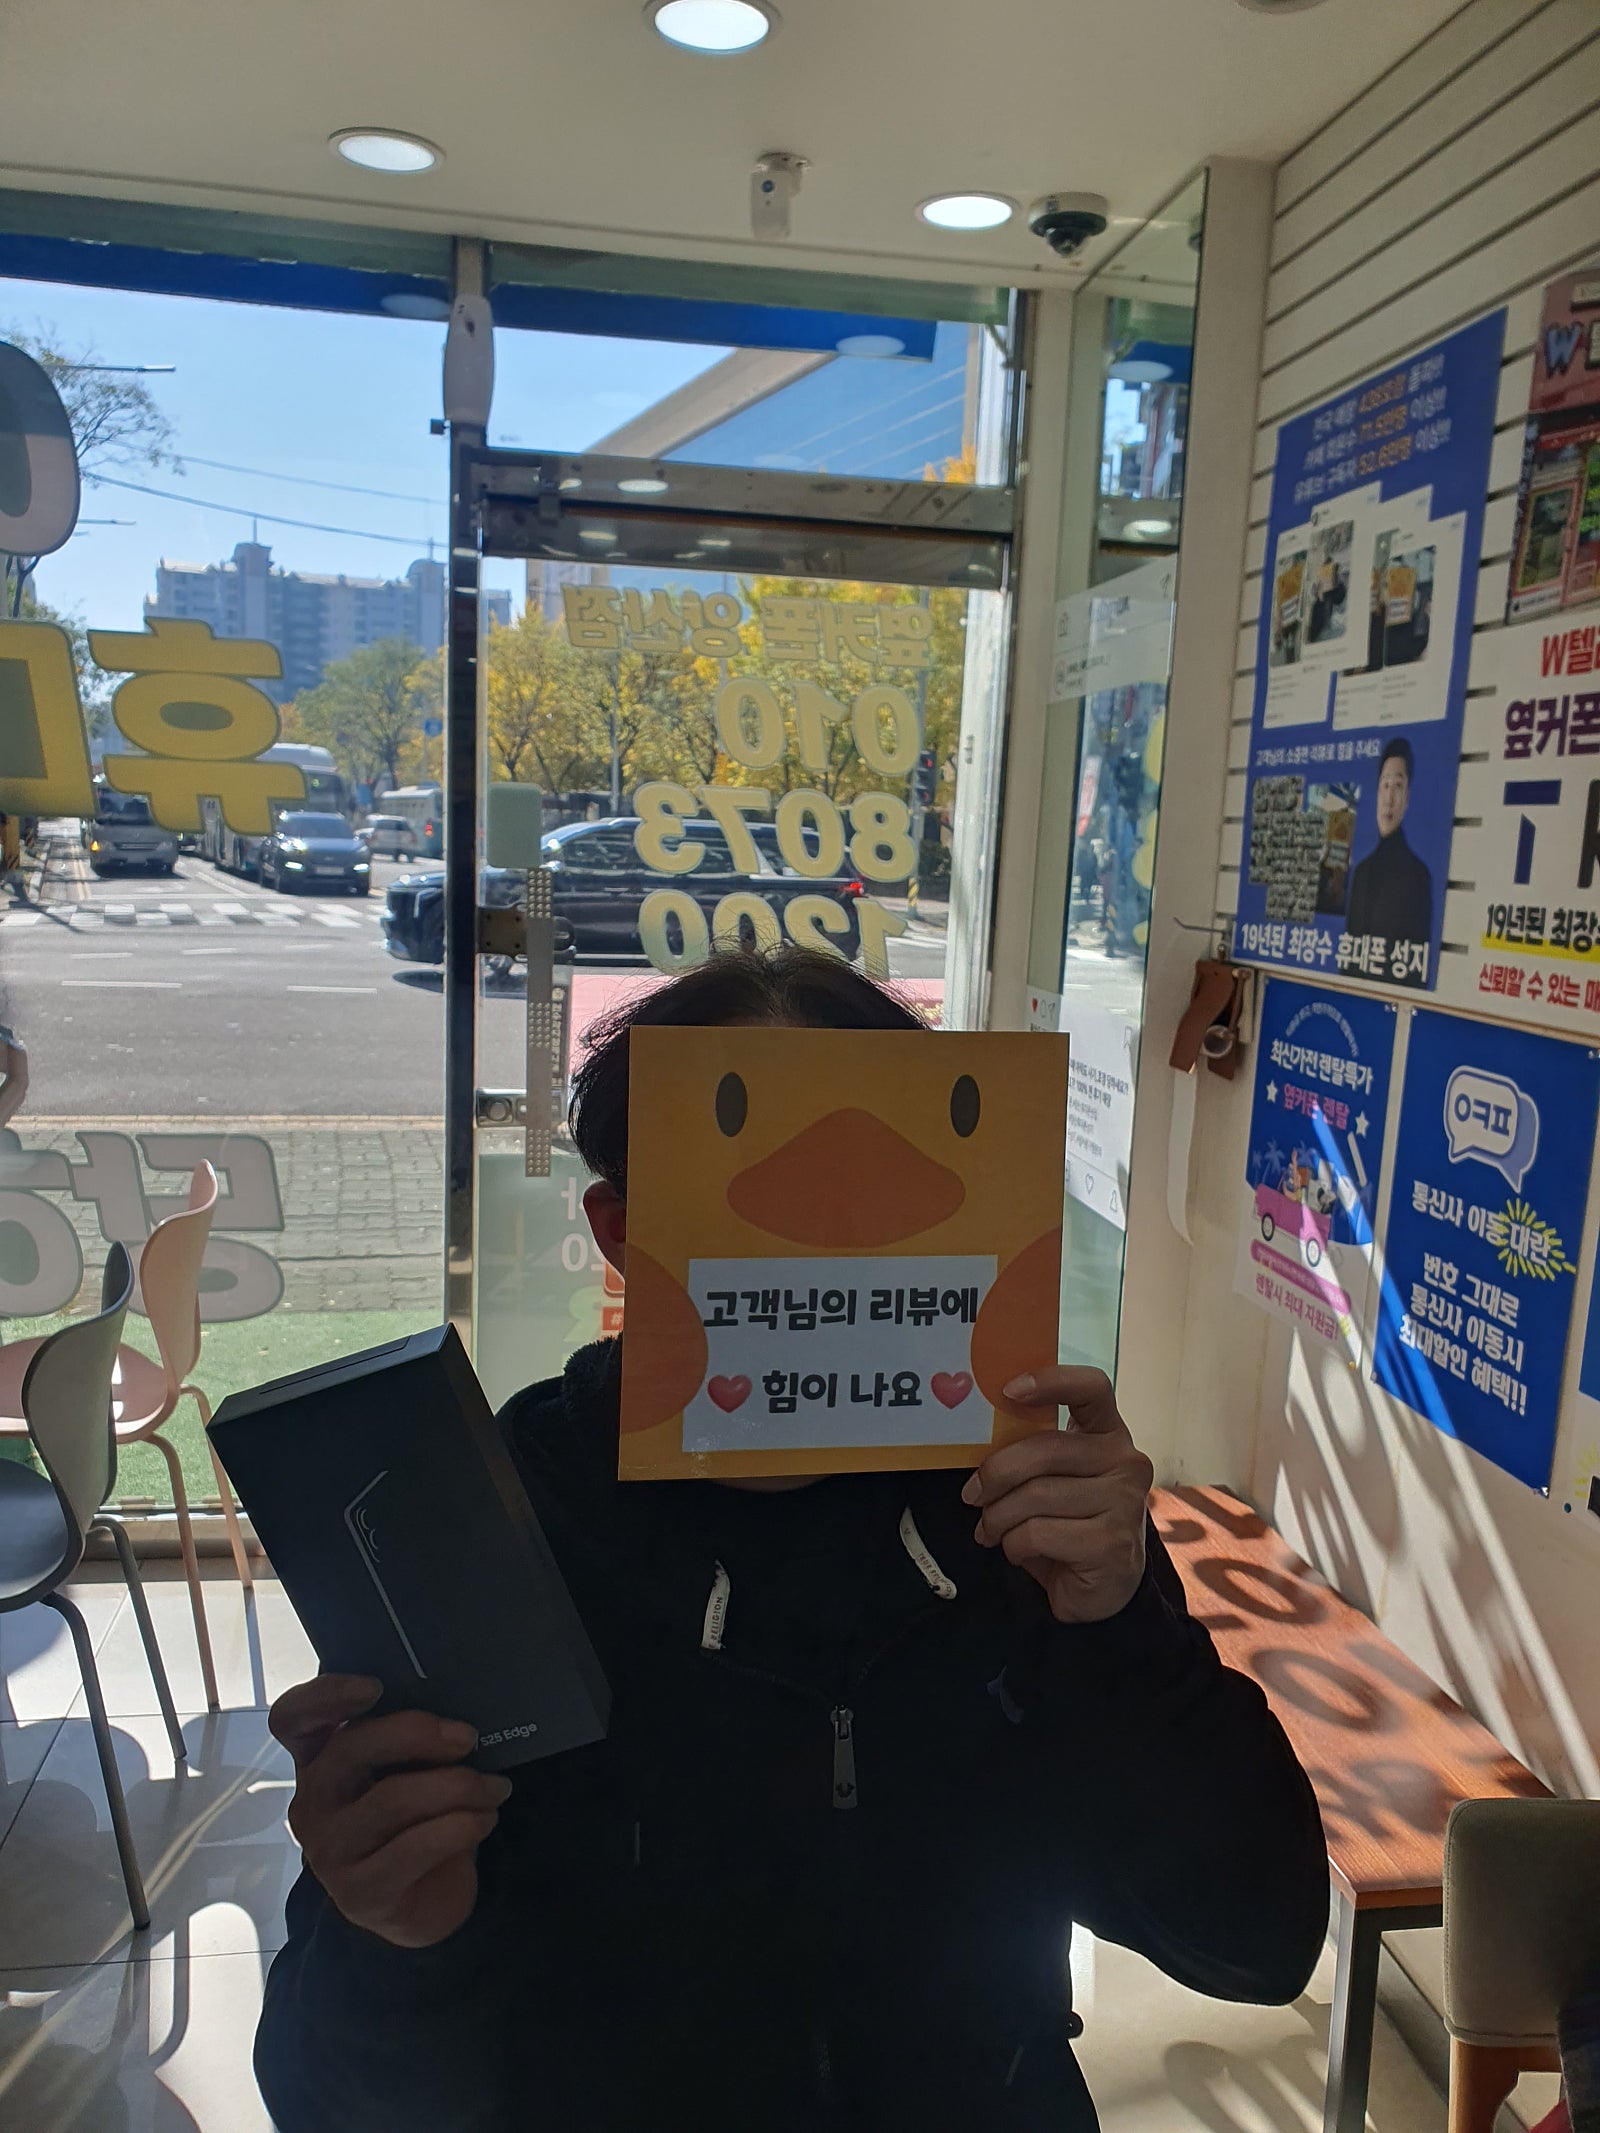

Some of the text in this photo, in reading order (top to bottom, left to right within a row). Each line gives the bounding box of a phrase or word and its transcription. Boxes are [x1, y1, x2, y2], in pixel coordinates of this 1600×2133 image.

[1541, 625, 1600, 677] W텔
[1486, 903, 1600, 952] 19년된 최장
[1242, 923, 1429, 983] 19년된 최장수 휴대폰 성지
[1478, 963, 1525, 997] 신뢰할
[1526, 970, 1543, 1000] 수
[1547, 972, 1580, 1008] 있는
[1284, 1084, 1350, 1130] 옆커폰 렌탈
[1454, 1093, 1512, 1136] ㅇㅋㅍ
[1412, 1180, 1550, 1267] 통신사 이동 대란
[704, 1287, 979, 1331] 고객님의 리뷰에
[1256, 1272, 1283, 1306] 렌탈시
[1284, 1290, 1304, 1320] 최대
[1423, 1252, 1519, 1329] 번호 그대로
[1410, 1282, 1524, 1373] 통신사 이동시
[1399, 1312, 1527, 1417] 최대할인 혜택!!
[762, 1370, 923, 1413] 힘이 나요
[710, 1596, 723, 1641] RELIGION
[480, 1722, 538, 1747] S25 Edge
